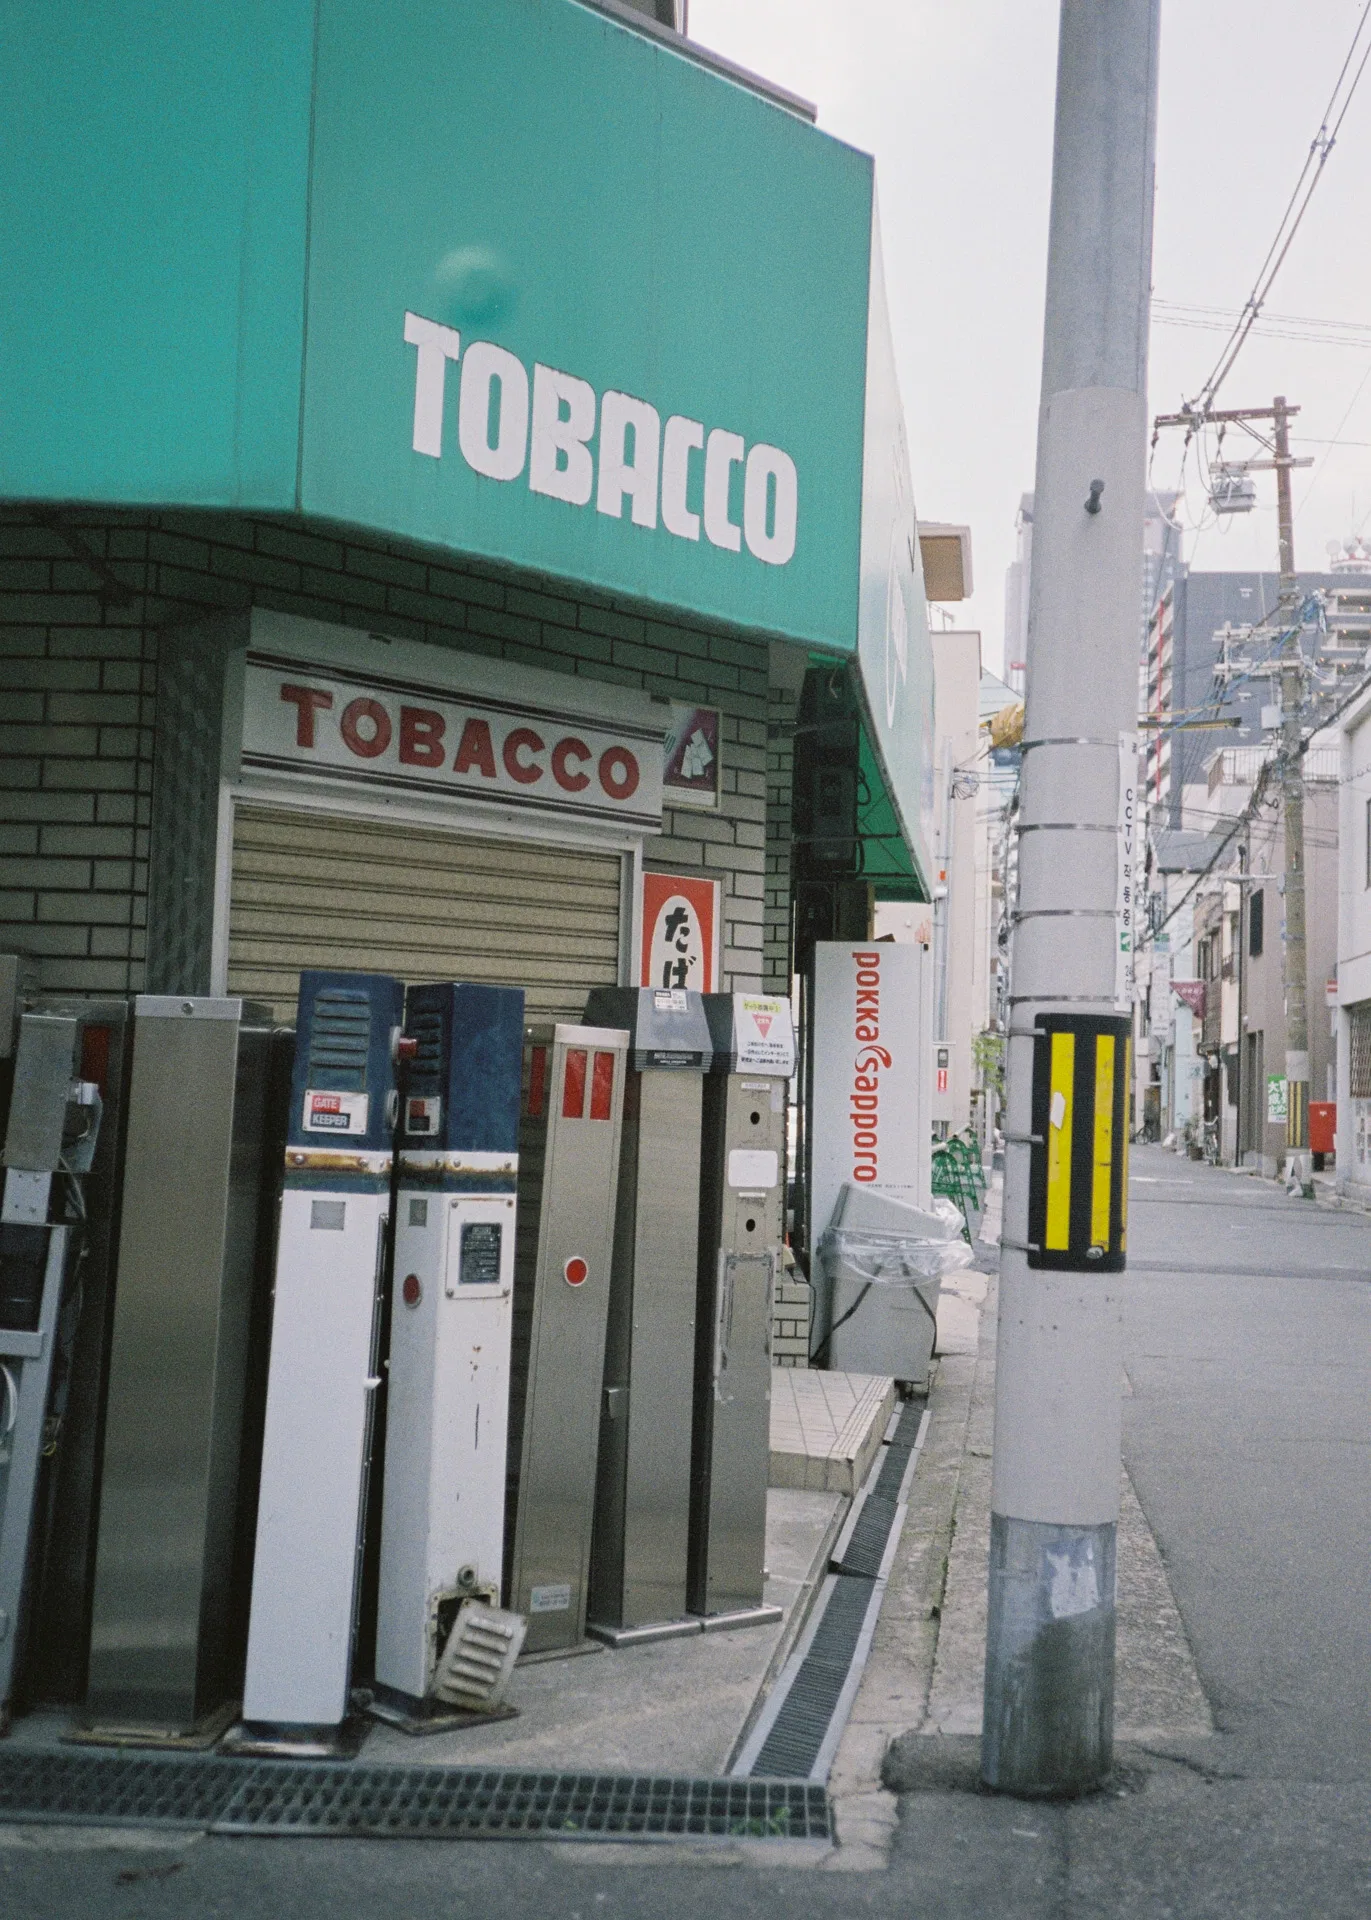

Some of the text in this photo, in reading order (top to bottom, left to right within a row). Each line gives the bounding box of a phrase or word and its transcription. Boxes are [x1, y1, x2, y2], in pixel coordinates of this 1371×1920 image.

[403, 310, 798, 565] TOBACCO
[280, 682, 640, 801] TOBACCO
[1124, 788, 1133, 855] CCTV
[312, 1113, 348, 1126] KEEPER
[314, 1097, 339, 1109] GATE
